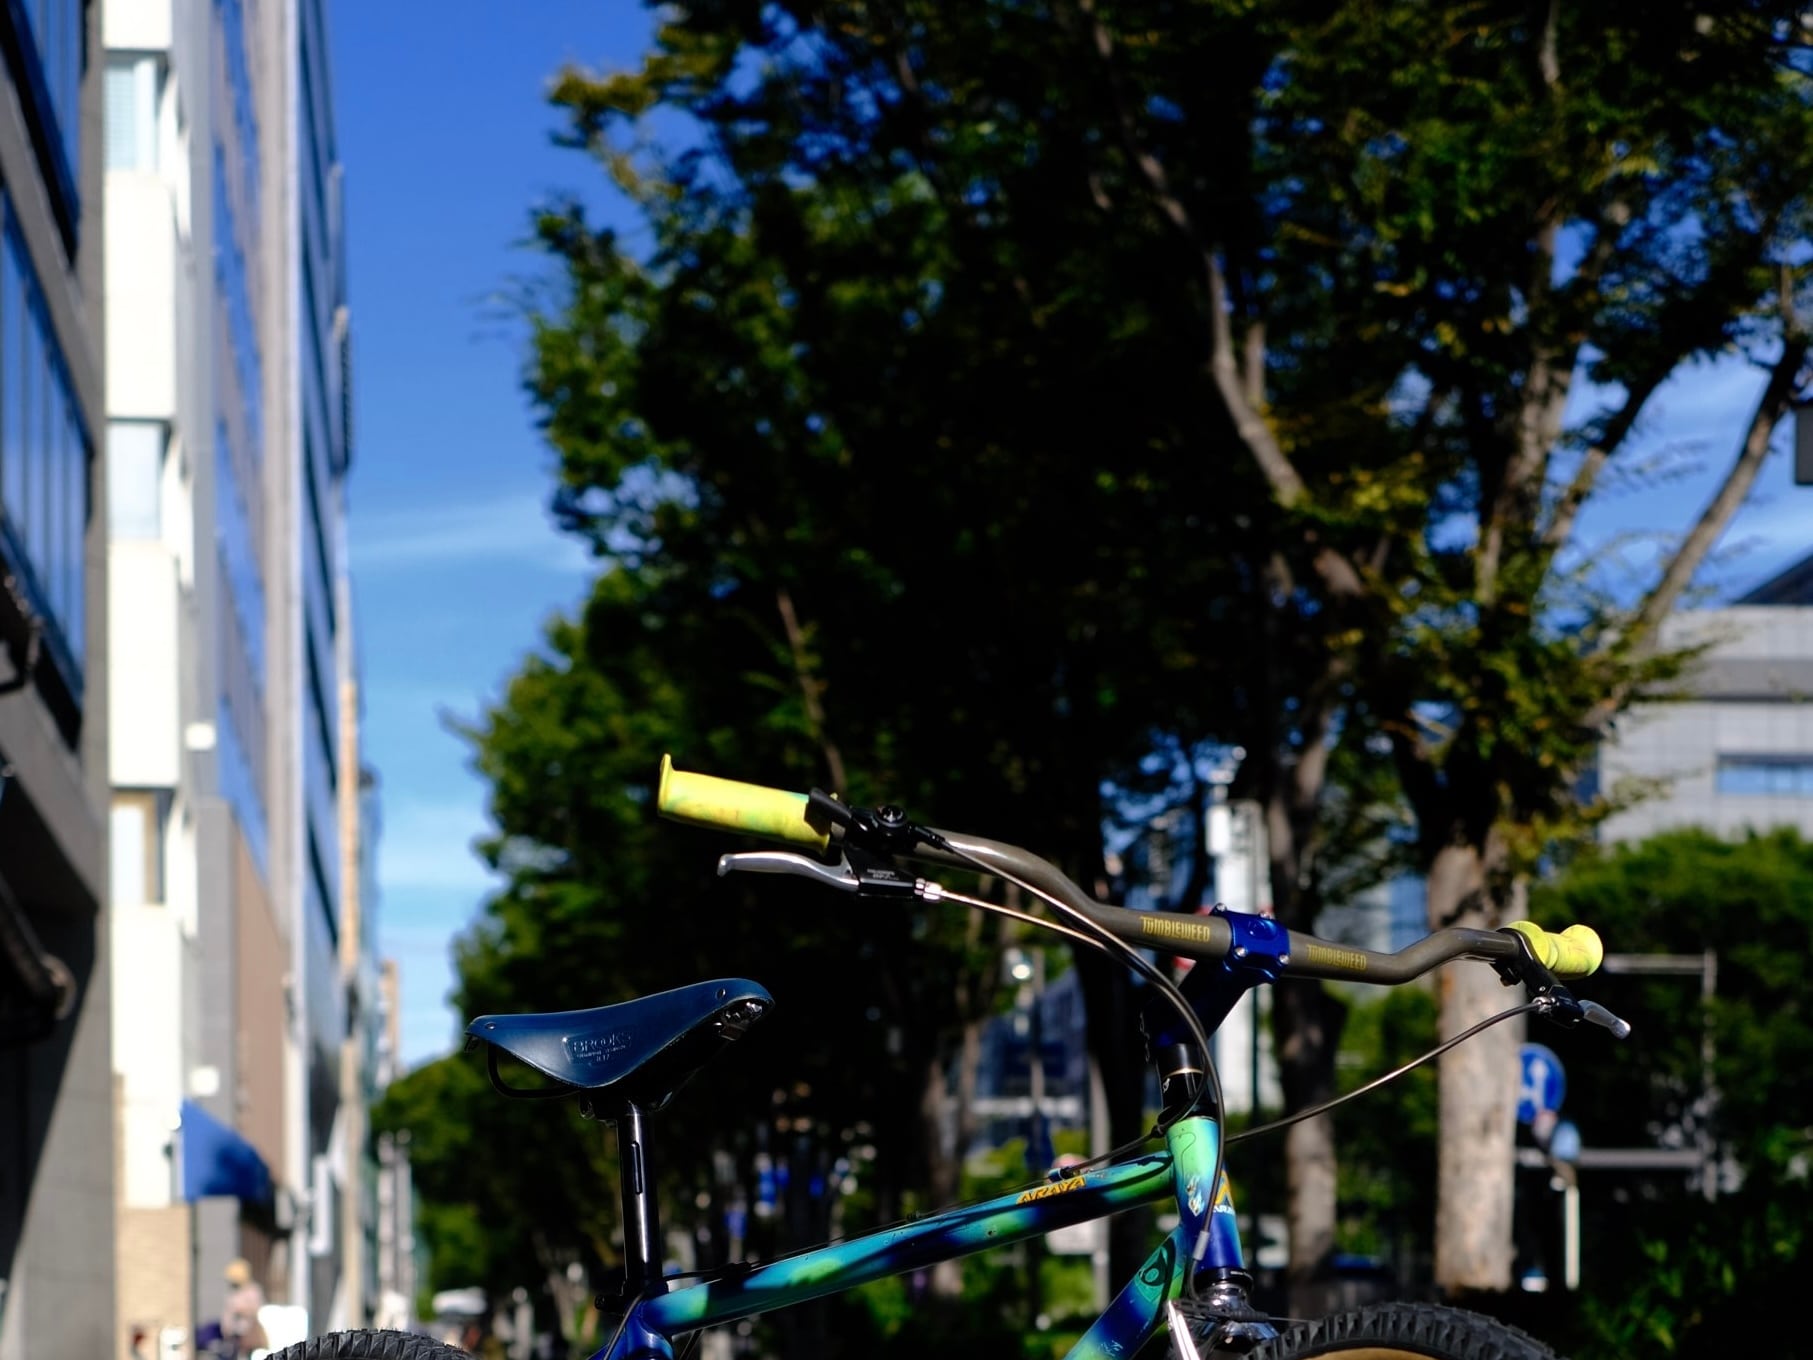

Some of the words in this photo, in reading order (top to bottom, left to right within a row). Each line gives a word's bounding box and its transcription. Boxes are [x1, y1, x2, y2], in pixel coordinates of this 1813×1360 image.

[1140, 916, 1210, 942] TUMBLEWEED
[1307, 944, 1367, 971] TUMBLEWEED
[1015, 1175, 1086, 1205] ARAYA
